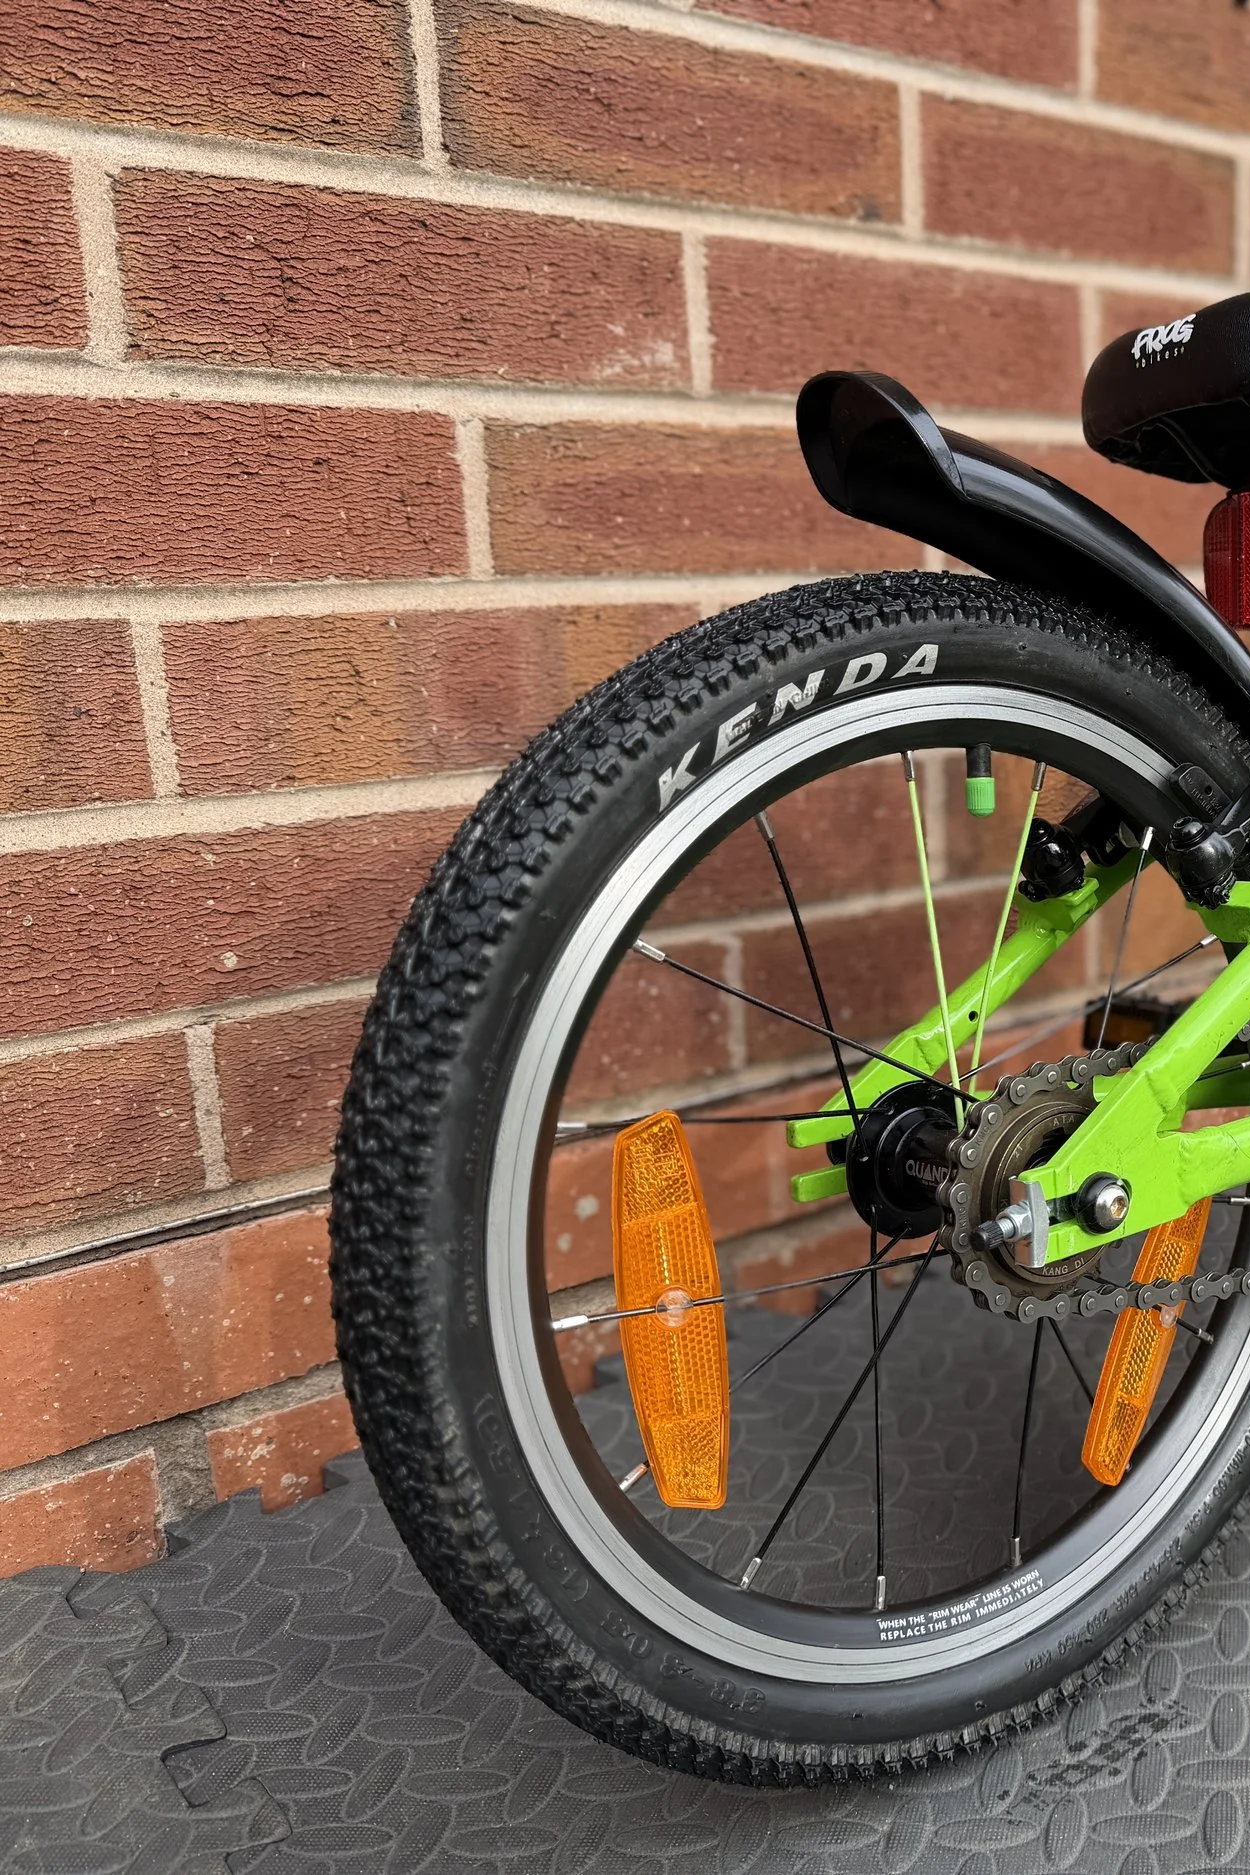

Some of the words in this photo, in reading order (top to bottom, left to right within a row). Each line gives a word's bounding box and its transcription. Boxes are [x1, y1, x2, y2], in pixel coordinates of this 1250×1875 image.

[1131, 313, 1197, 360] FROG
[658, 643, 939, 812] KENDA
[906, 1160, 957, 1182] QUAND
[1042, 1264, 1068, 1276] KANG
[1074, 1257, 1085, 1268] DI
[878, 1618, 907, 1630] WHEN
[908, 1614, 926, 1626] THE
[982, 1588, 1002, 1604] LINE
[1001, 1584, 1012, 1594] IS
[1011, 1569, 1040, 1590] WORN
[880, 1625, 927, 1641] REPLACE
[928, 1619, 948, 1632] THE
[950, 1612, 972, 1627] RIM
[975, 1578, 1044, 1617] IMMEDIATELY
